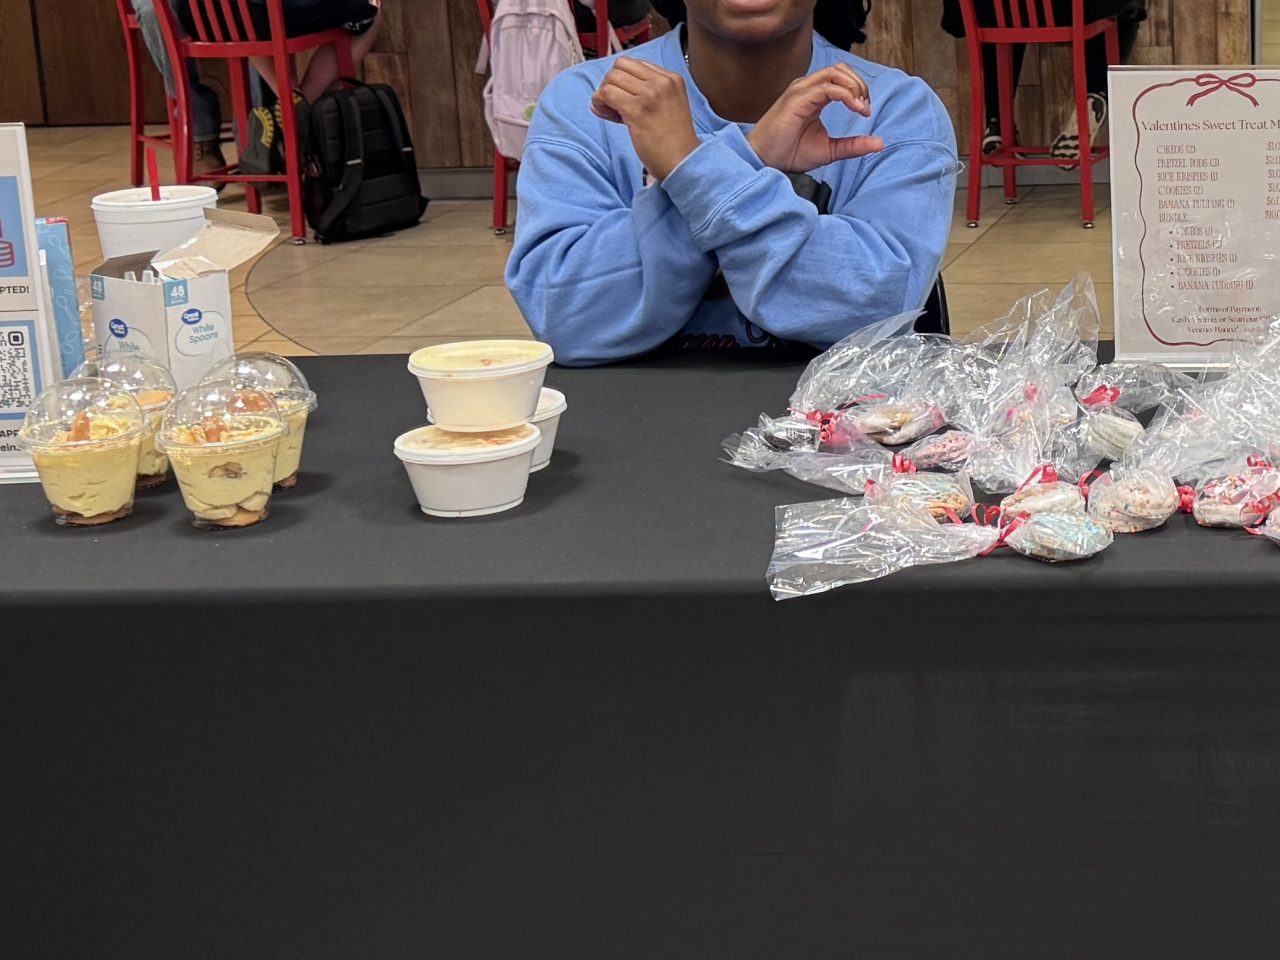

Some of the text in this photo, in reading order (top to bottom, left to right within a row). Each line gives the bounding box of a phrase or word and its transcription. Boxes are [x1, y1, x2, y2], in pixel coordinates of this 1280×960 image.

[1141, 120, 1200, 131] Valentines
[1203, 120, 1236, 131] Sweet
[1238, 120, 1267, 130] Treat
[1157, 145, 1184, 154] OREOS
[1157, 158, 1187, 168] PRETZEL
[1158, 172, 1173, 181] RICE
[1158, 186, 1192, 195] COOKIES
[1158, 199, 1190, 209] BANANA
[0, 286, 30, 294] PTED!
[171, 286, 185, 297] 48
[192, 324, 215, 334] White
[189, 331, 218, 345] Spoons
